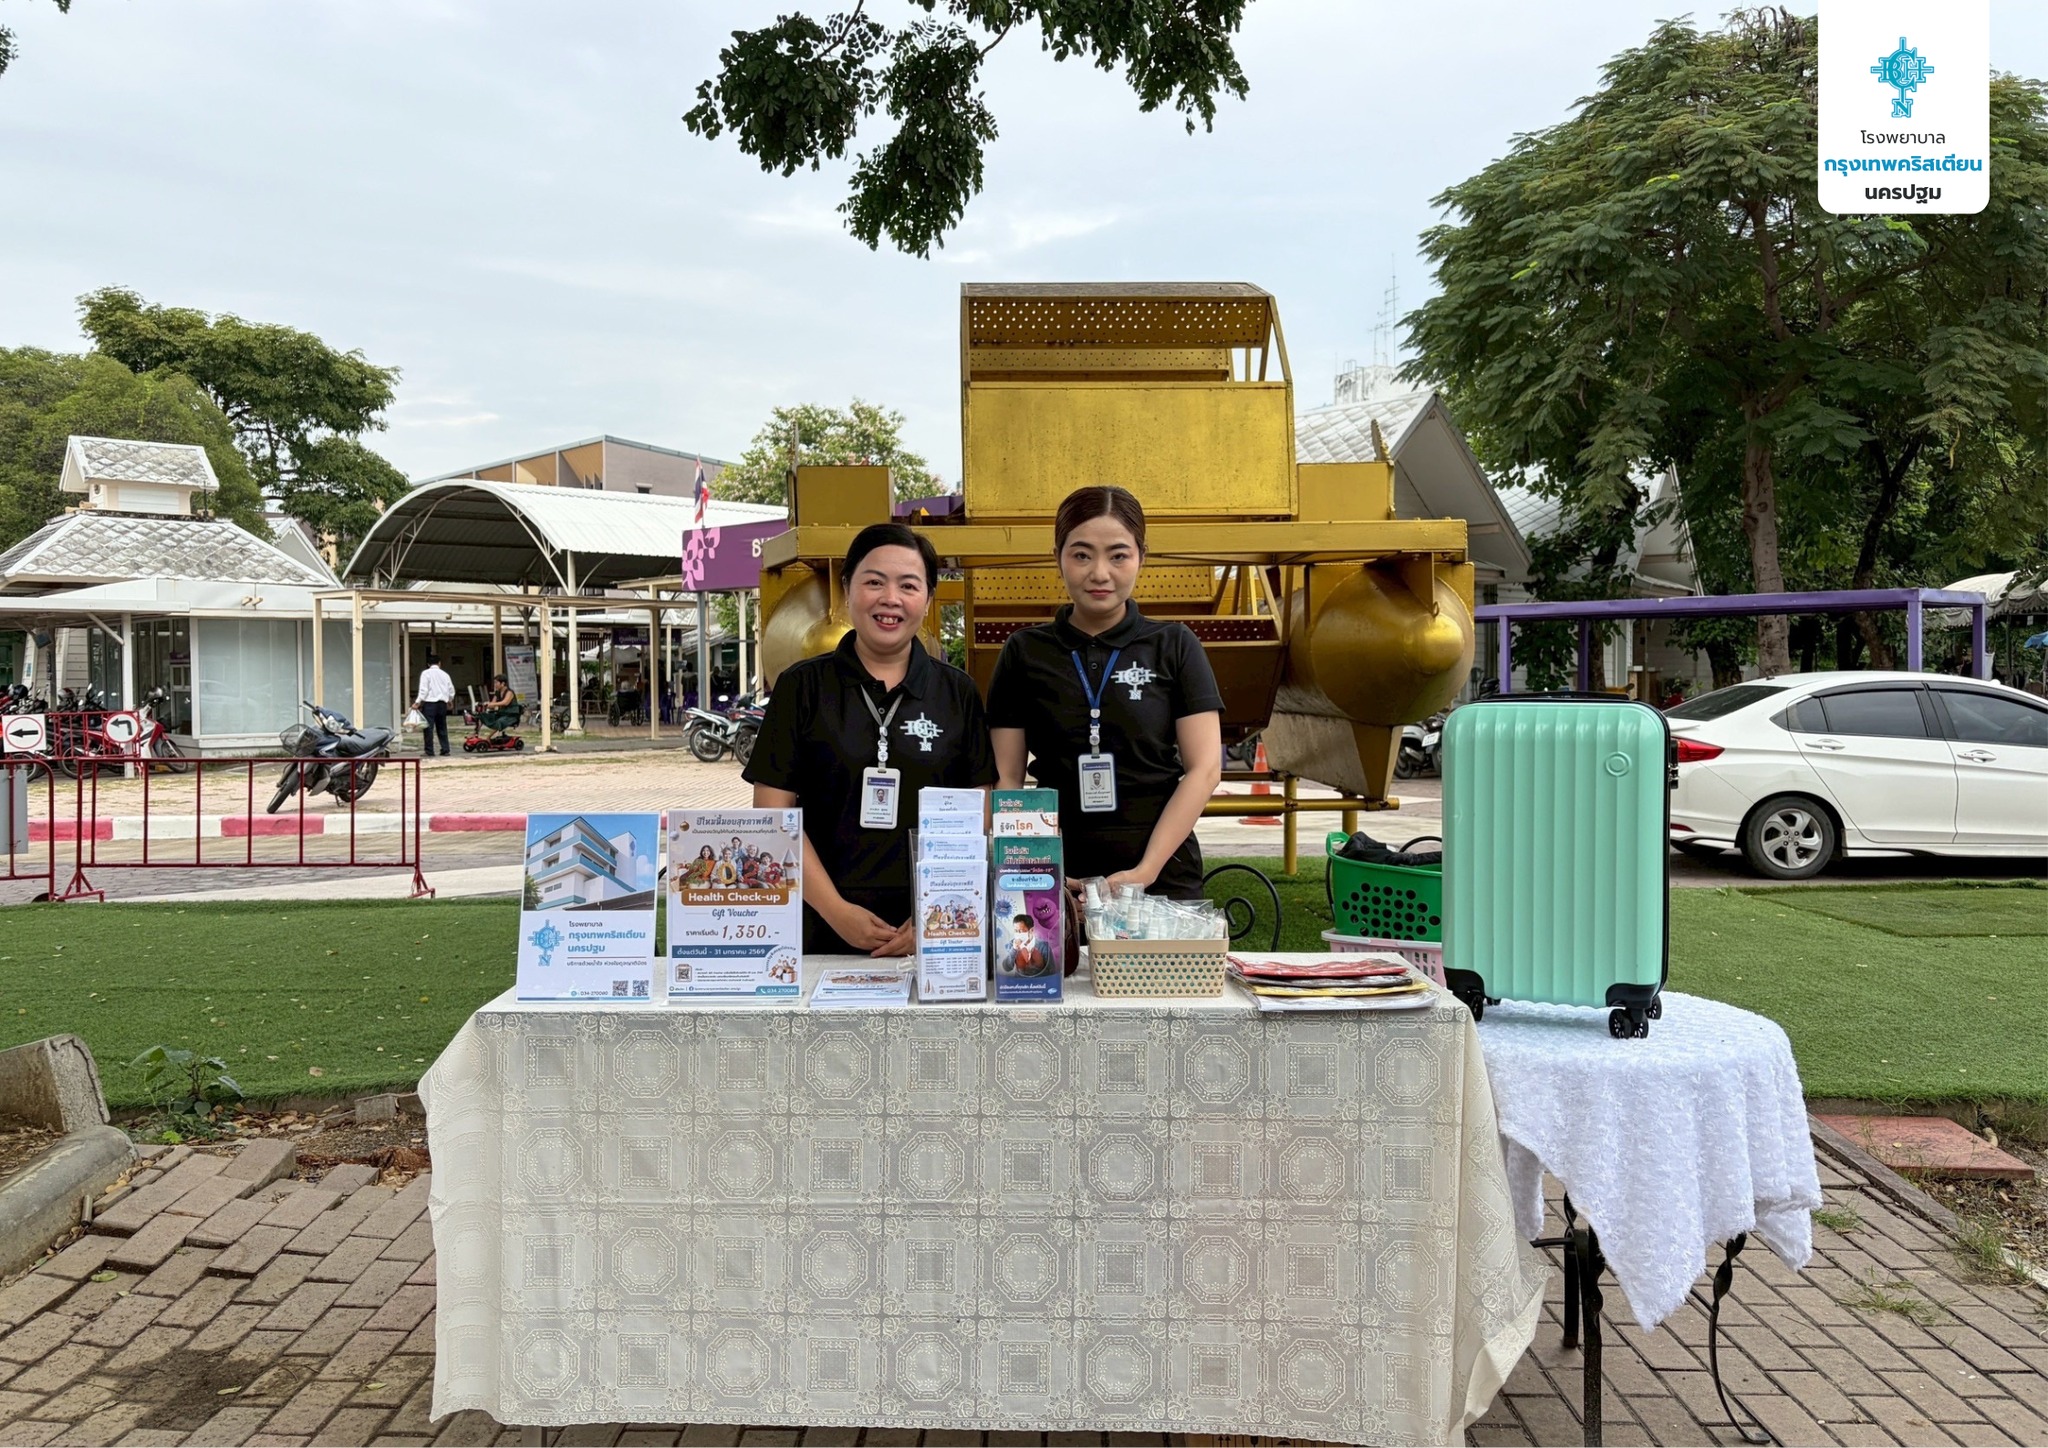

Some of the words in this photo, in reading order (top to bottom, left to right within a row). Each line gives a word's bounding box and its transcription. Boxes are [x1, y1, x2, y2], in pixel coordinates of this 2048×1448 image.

[688, 892, 724, 902] Health
[727, 892, 781, 904] Check-up
[712, 908, 725, 920] Gift
[727, 908, 759, 918] Voucher
[569, 920, 603, 928] โรงพยาบาล
[568, 930, 646, 942] กรุงเทพคริสเตียน
[685, 928, 719, 936] ราคาเริ่มต้น
[567, 943, 606, 954] นครปฐม
[676, 948, 708, 956] ตั้งแต่วันนี้
